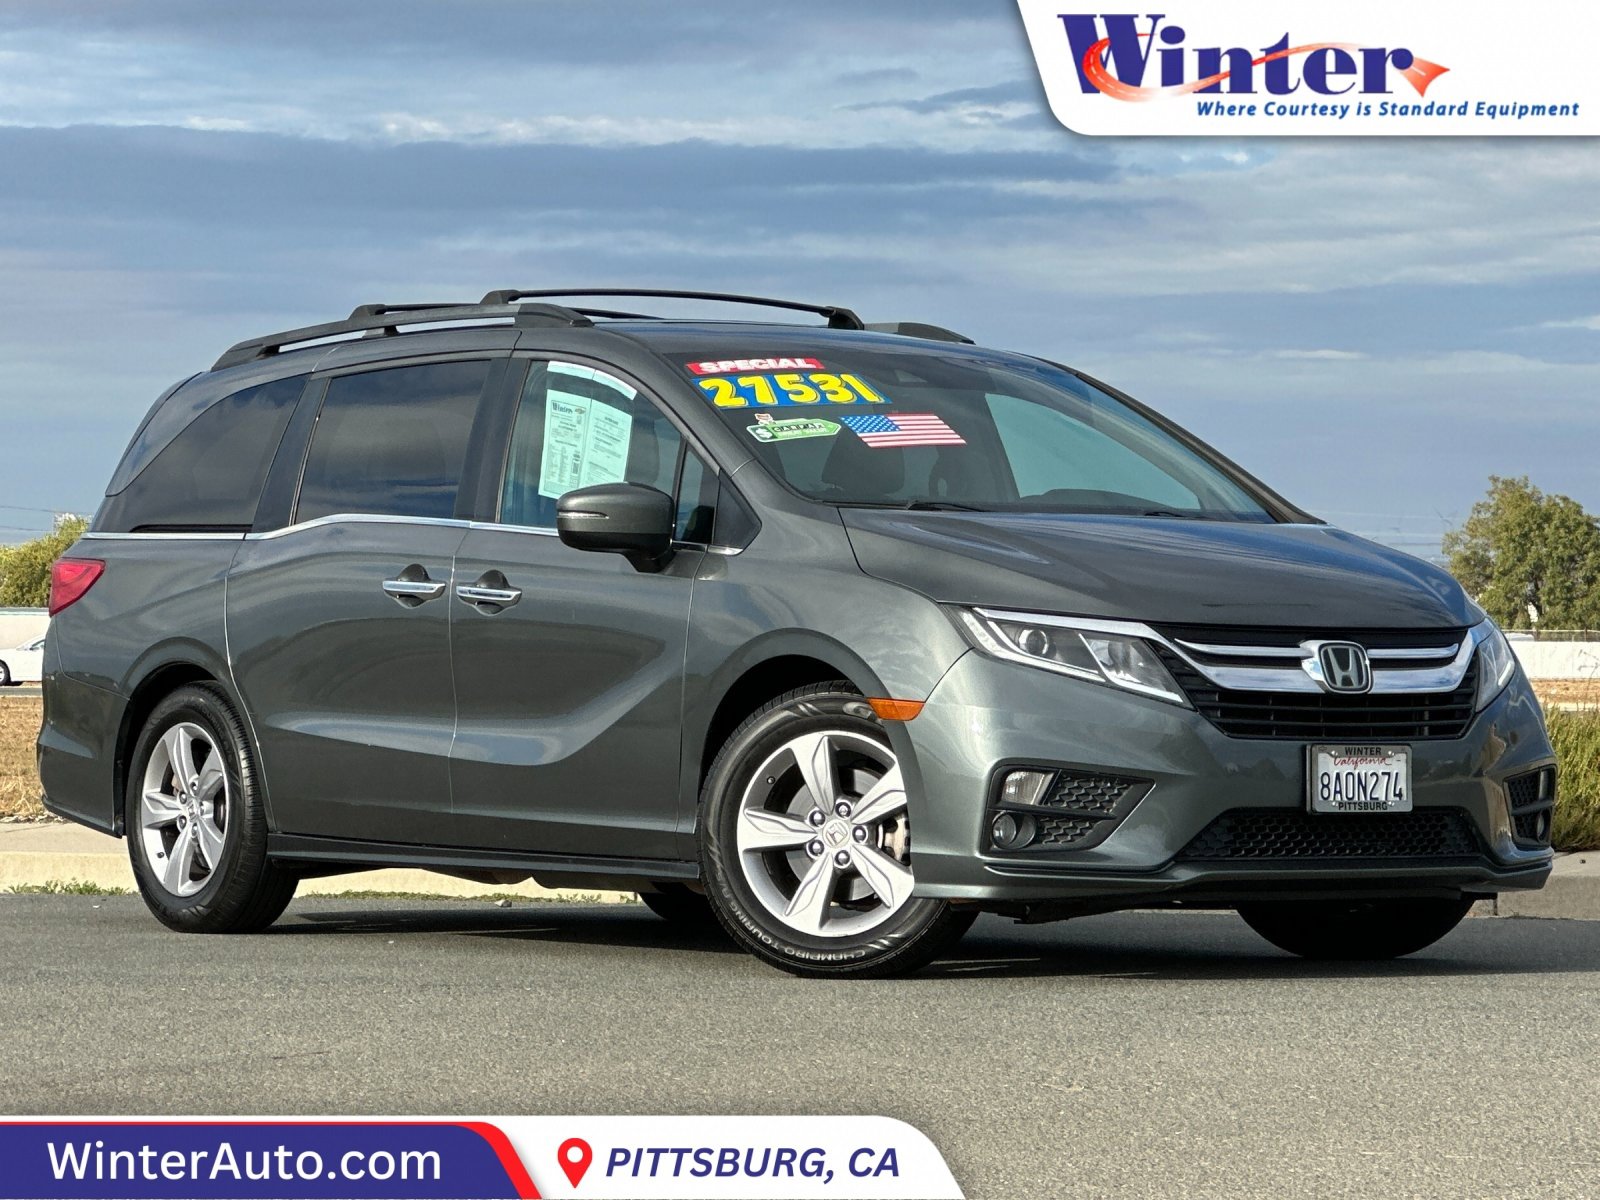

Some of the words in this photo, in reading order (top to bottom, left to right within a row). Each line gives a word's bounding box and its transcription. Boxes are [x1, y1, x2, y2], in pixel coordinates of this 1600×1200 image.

[698, 357, 817, 373] SPECIAL
[699, 373, 886, 408] 27531
[1344, 746, 1382, 756] WINTER
[1333, 756, 1392, 770] California
[1338, 801, 1388, 811] PITTSBURG
[729, 901, 780, 951] TOURING
[783, 946, 866, 961] CHAMPIRO
